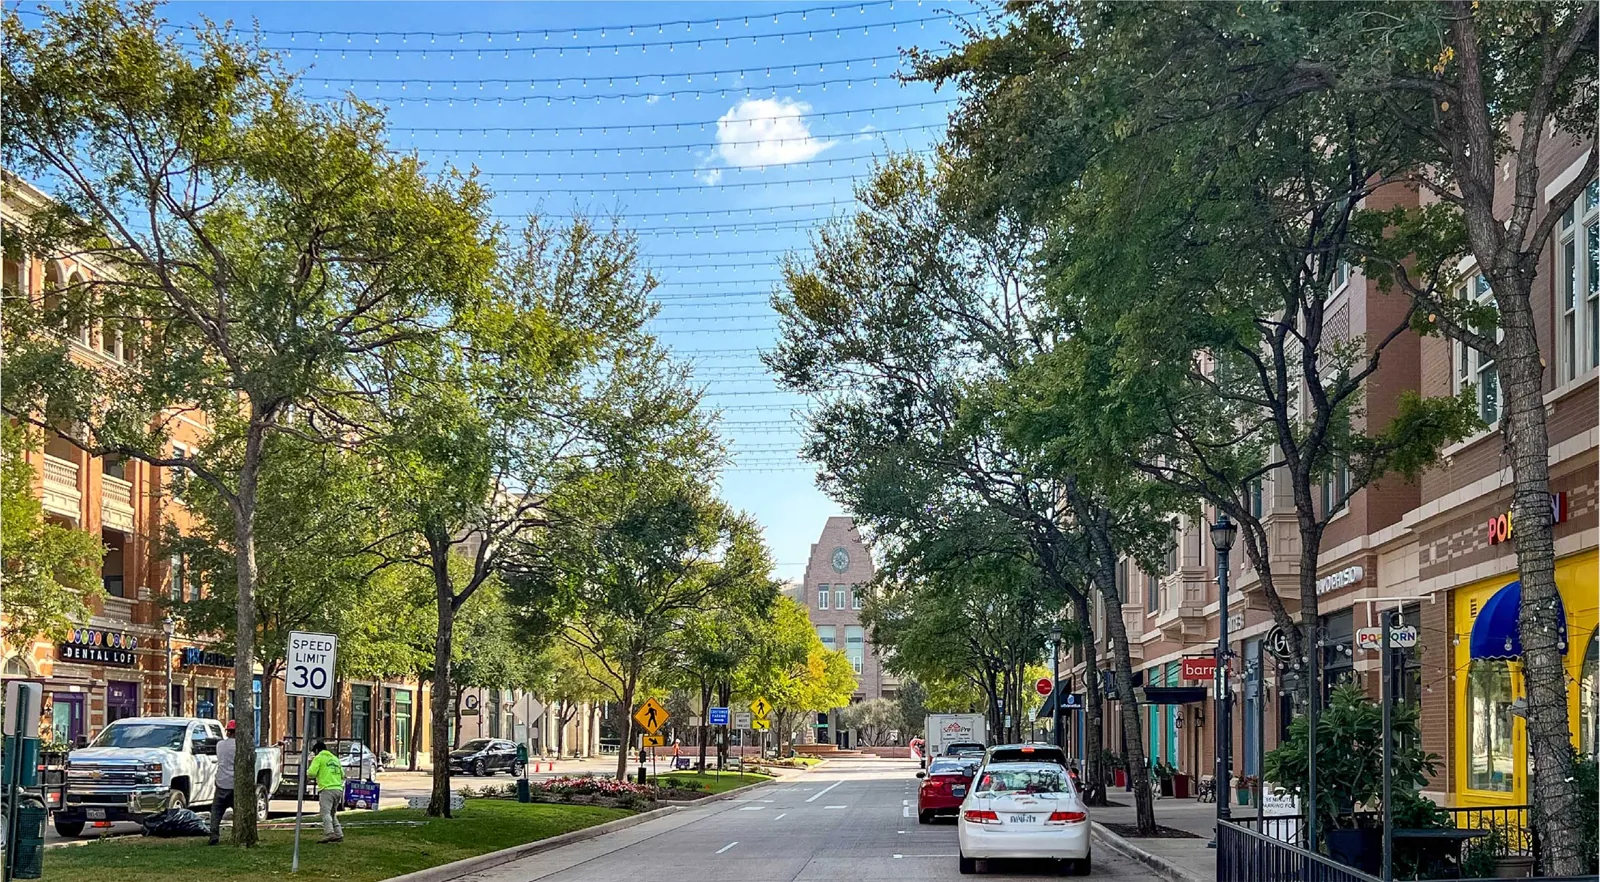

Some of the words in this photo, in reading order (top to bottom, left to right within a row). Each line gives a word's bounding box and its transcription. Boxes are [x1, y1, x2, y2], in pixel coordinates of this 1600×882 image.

[1361, 633, 1415, 642] POPORN
[293, 639, 332, 651] SPEED
[67, 647, 109, 661] DENTAL
[114, 652, 137, 664] LOFT
[296, 652, 326, 664] LIMIT
[1185, 664, 1216, 676] barr
[292, 665, 327, 690] 30
